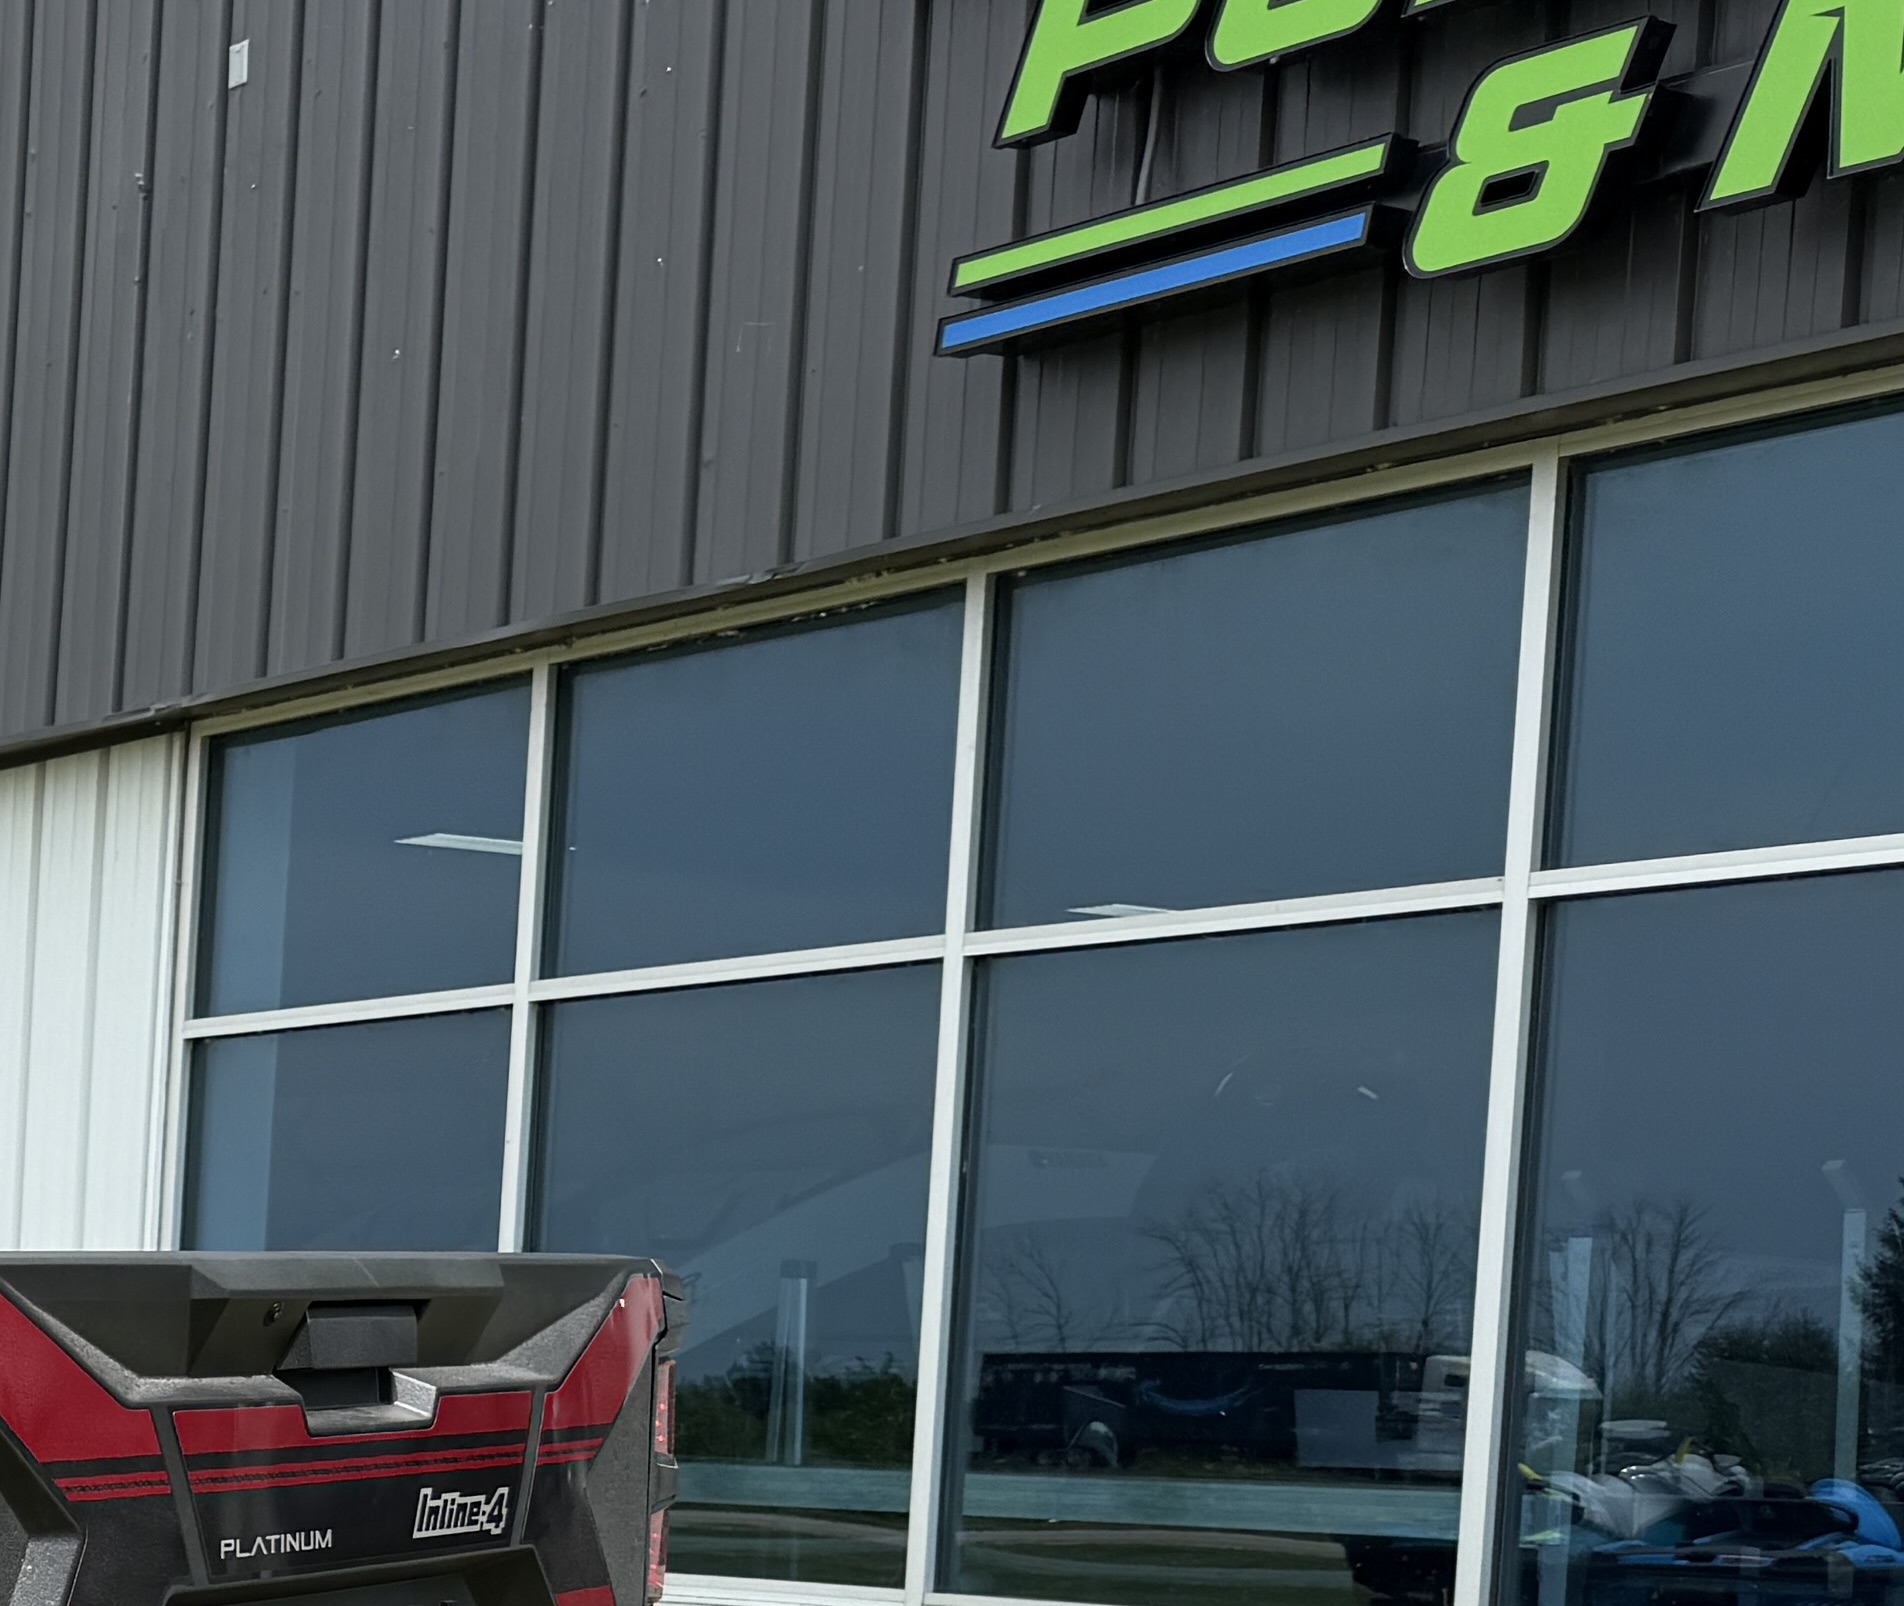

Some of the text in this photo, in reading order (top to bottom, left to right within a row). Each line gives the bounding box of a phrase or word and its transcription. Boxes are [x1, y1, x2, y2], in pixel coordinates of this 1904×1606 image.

[1404, 15, 1669, 279] &
[412, 1486, 509, 1540] Inline-4
[220, 1529, 333, 1560] PLATINUM
